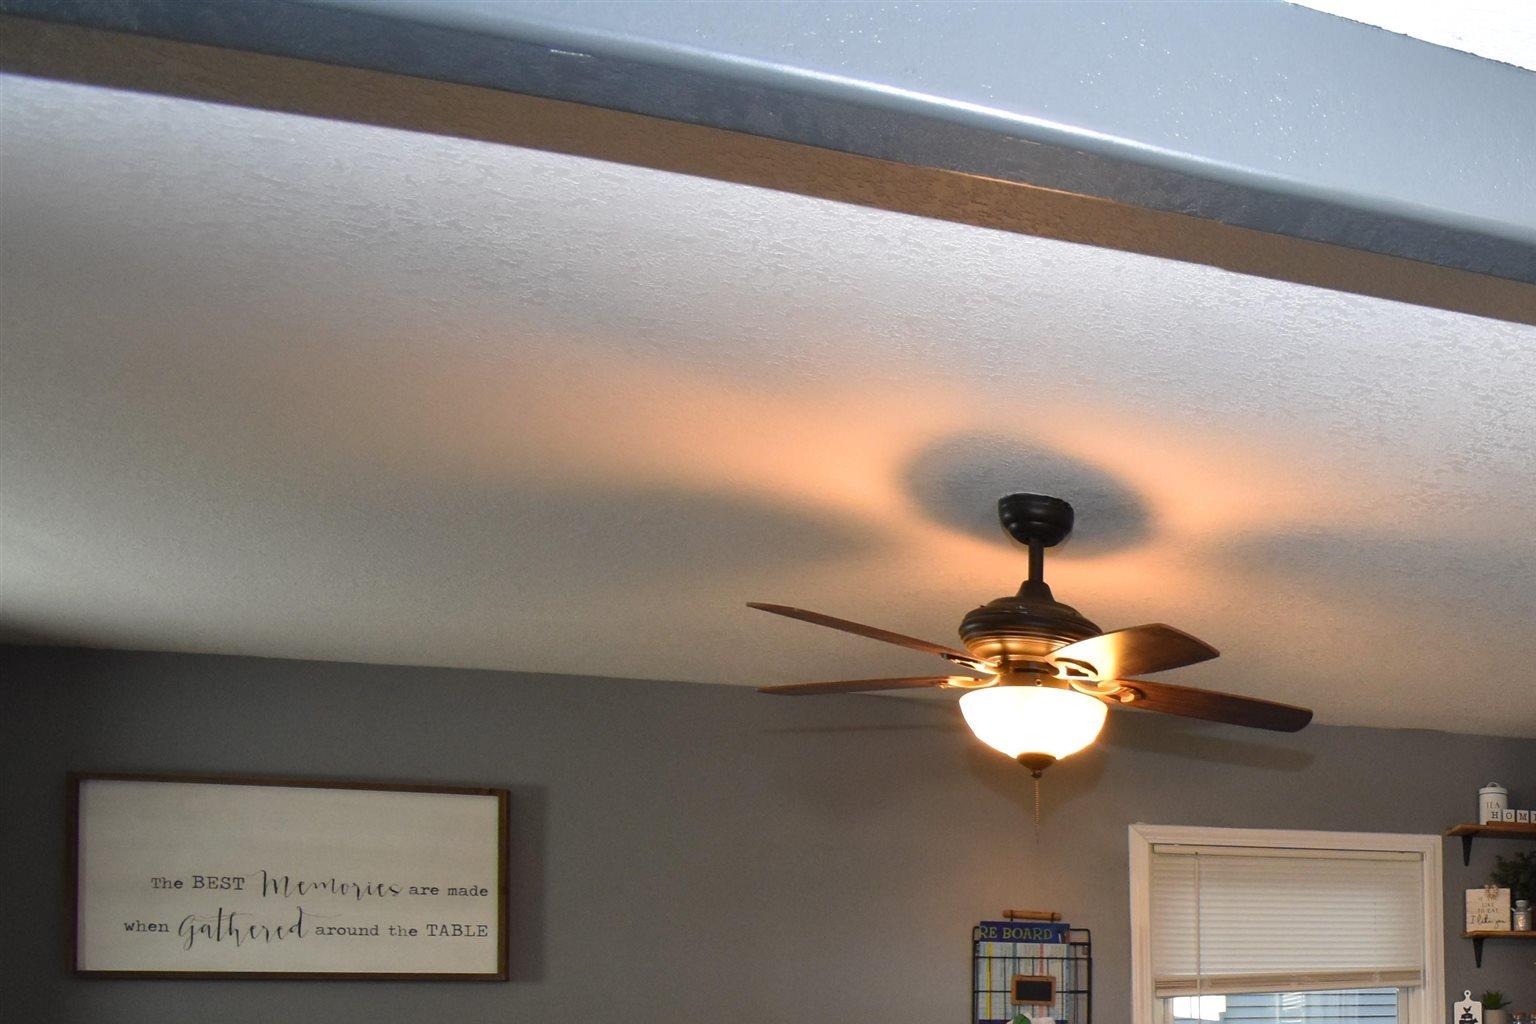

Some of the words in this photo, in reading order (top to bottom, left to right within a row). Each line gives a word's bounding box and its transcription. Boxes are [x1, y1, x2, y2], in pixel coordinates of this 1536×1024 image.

[151, 877, 184, 889] The
[192, 875, 246, 890] BEST
[252, 869, 402, 900] Memories
[408, 886, 440, 896] are
[447, 885, 489, 896] made
[124, 920, 170, 933] when
[315, 925, 379, 937] around
[388, 924, 418, 937] the
[426, 924, 489, 937] TABLE
[1002, 926, 1053, 940] BOARD
